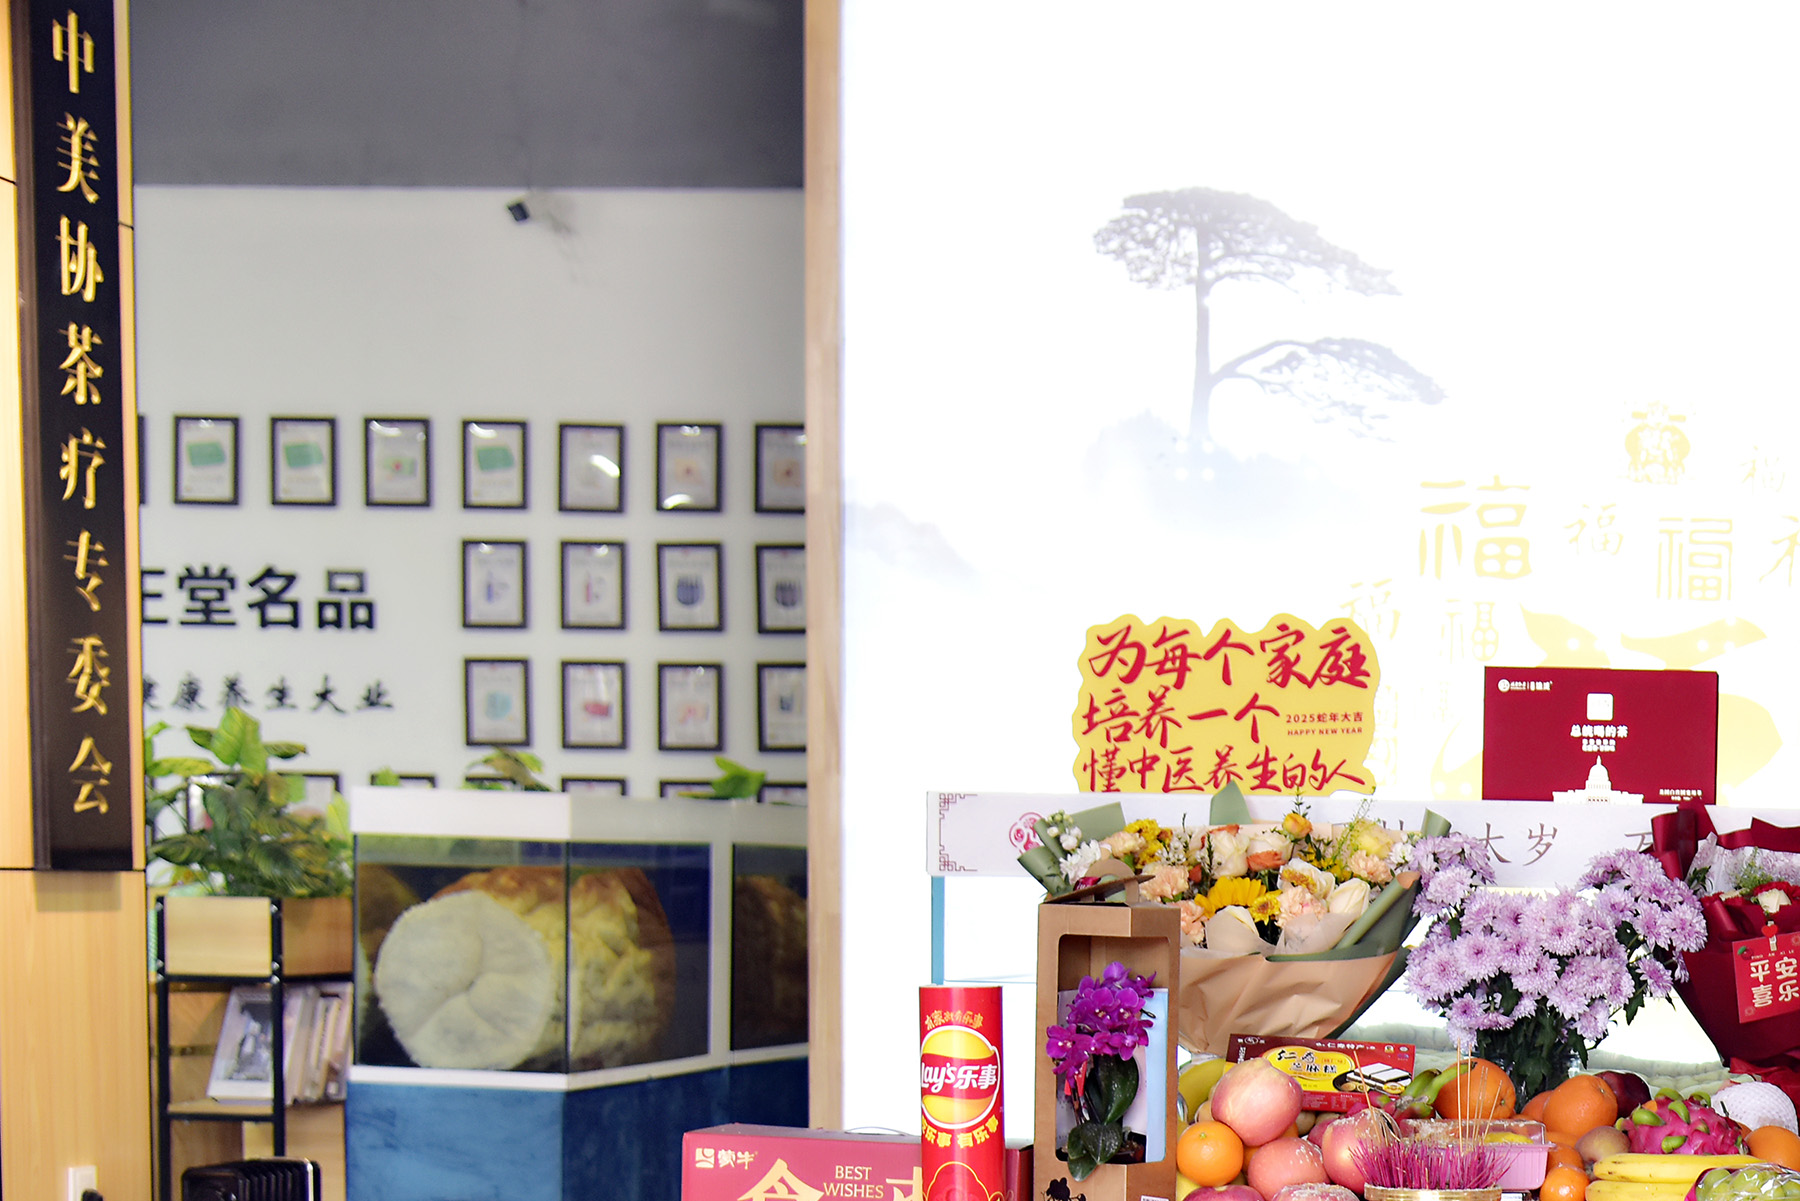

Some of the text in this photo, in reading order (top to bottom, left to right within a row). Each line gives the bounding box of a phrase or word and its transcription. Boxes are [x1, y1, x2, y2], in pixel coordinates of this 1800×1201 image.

[51, 9, 113, 816] 中美协茶疗专委会
[1420, 473, 1533, 581] 福
[1088, 623, 1371, 690] 为每个家庭
[1082, 685, 1280, 749] 培养一个
[1286, 712, 1363, 725] 2025蛇年大吉
[1287, 727, 1363, 736] HAPPY NEW YEAR
[1083, 745, 1366, 793] 懂中医养生的人
[1750, 956, 1798, 982] 平安
[1751, 979, 1800, 1008] 喜乐
[835, 1165, 872, 1180] BEST
[823, 1182, 884, 1199] WISHES
